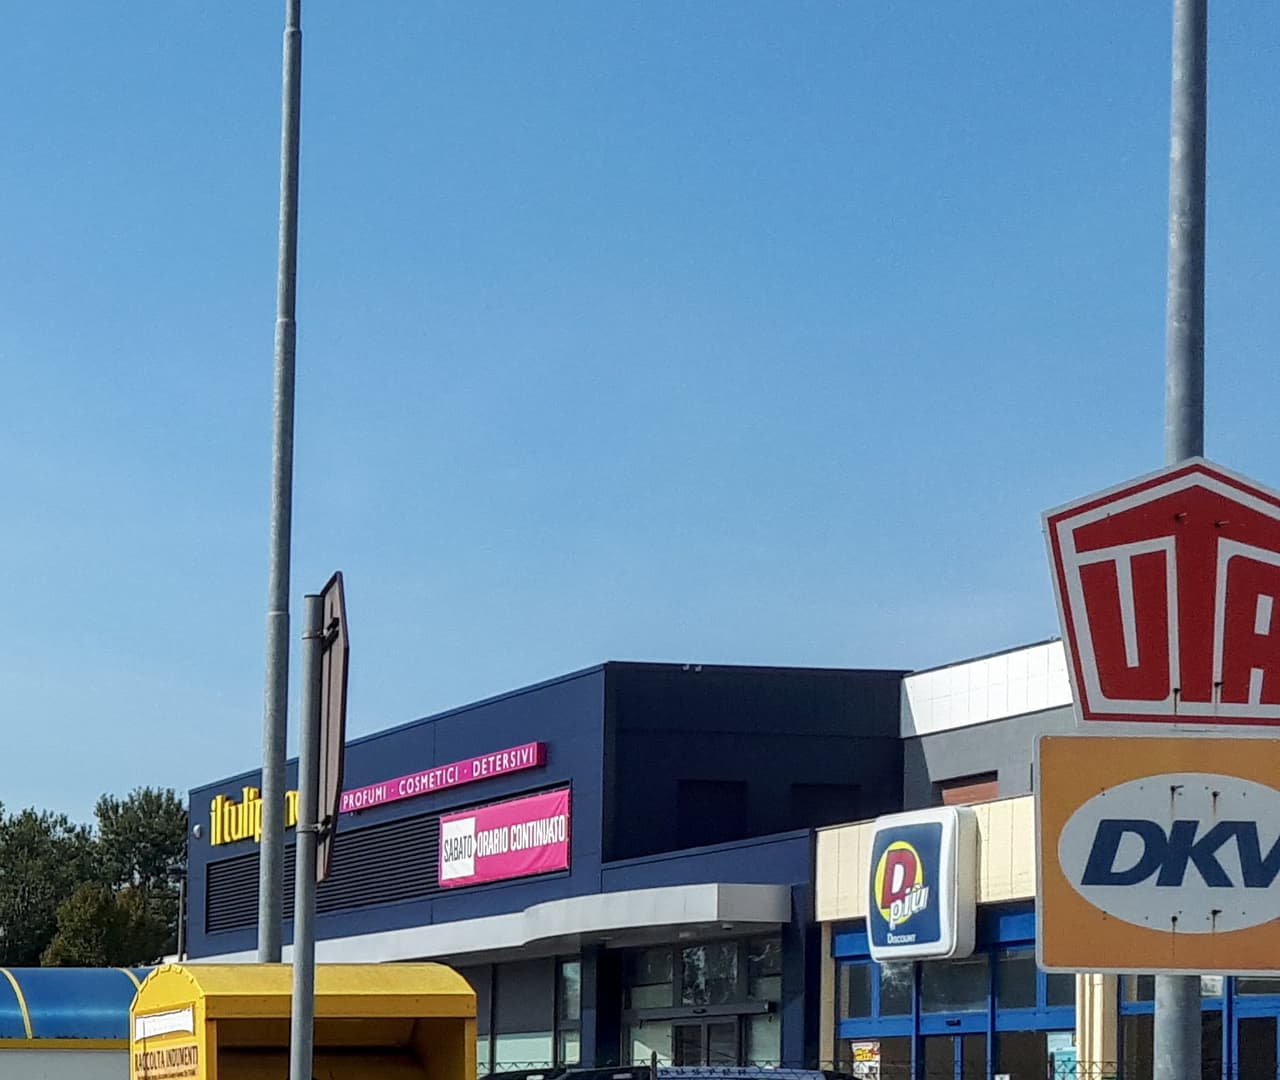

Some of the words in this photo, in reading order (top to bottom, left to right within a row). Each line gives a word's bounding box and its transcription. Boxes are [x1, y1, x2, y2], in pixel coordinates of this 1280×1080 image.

[343, 786, 387, 810] PROFUMI
[399, 766, 459, 796] COSMETICI
[472, 746, 534, 777] DETERSIVI
[443, 834, 473, 863] SABATO
[477, 827, 508, 857] ORARIO
[510, 814, 566, 851] CONTINUATO
[881, 848, 918, 910] D
[888, 883, 930, 931] più
